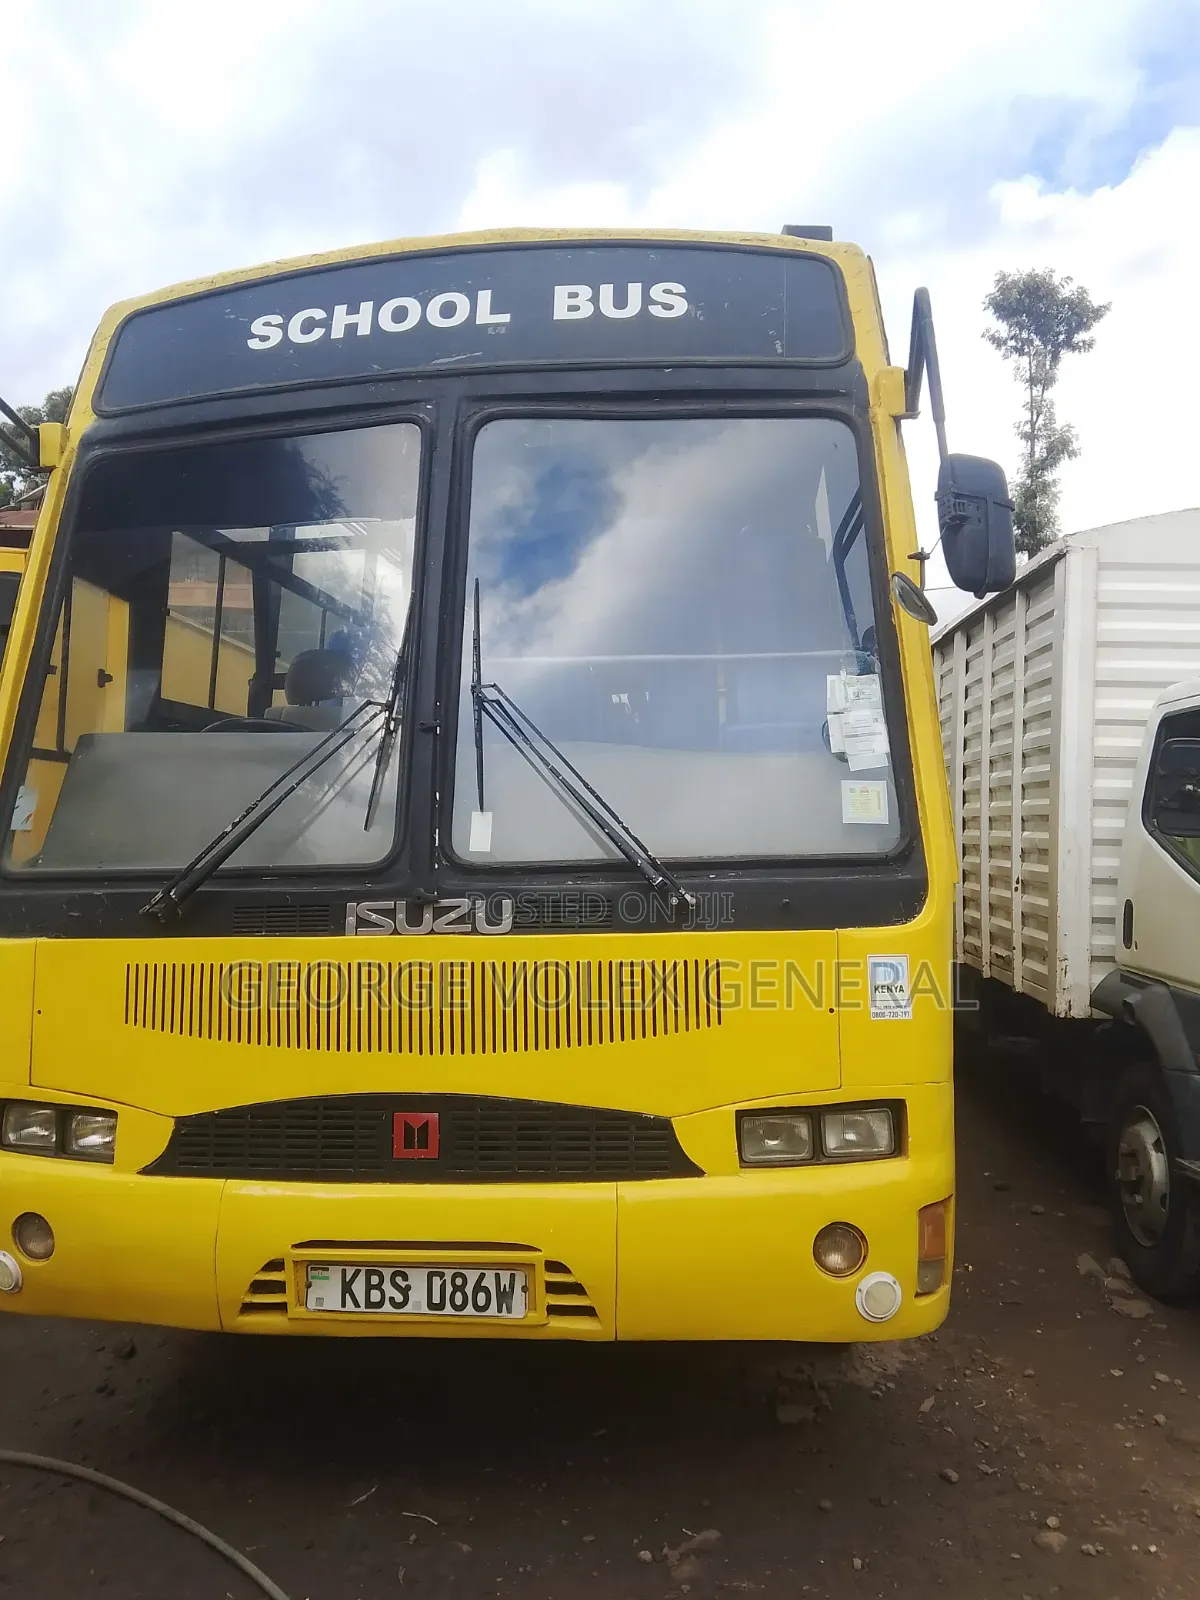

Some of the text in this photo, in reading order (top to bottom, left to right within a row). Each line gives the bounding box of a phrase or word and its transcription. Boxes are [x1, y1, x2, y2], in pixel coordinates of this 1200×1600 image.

[246, 282, 689, 350] SCHOOL BUS
[345, 898, 513, 936] ISUZU
[873, 984, 905, 994] KENYA
[340, 1268, 516, 1314] KBS 086W
